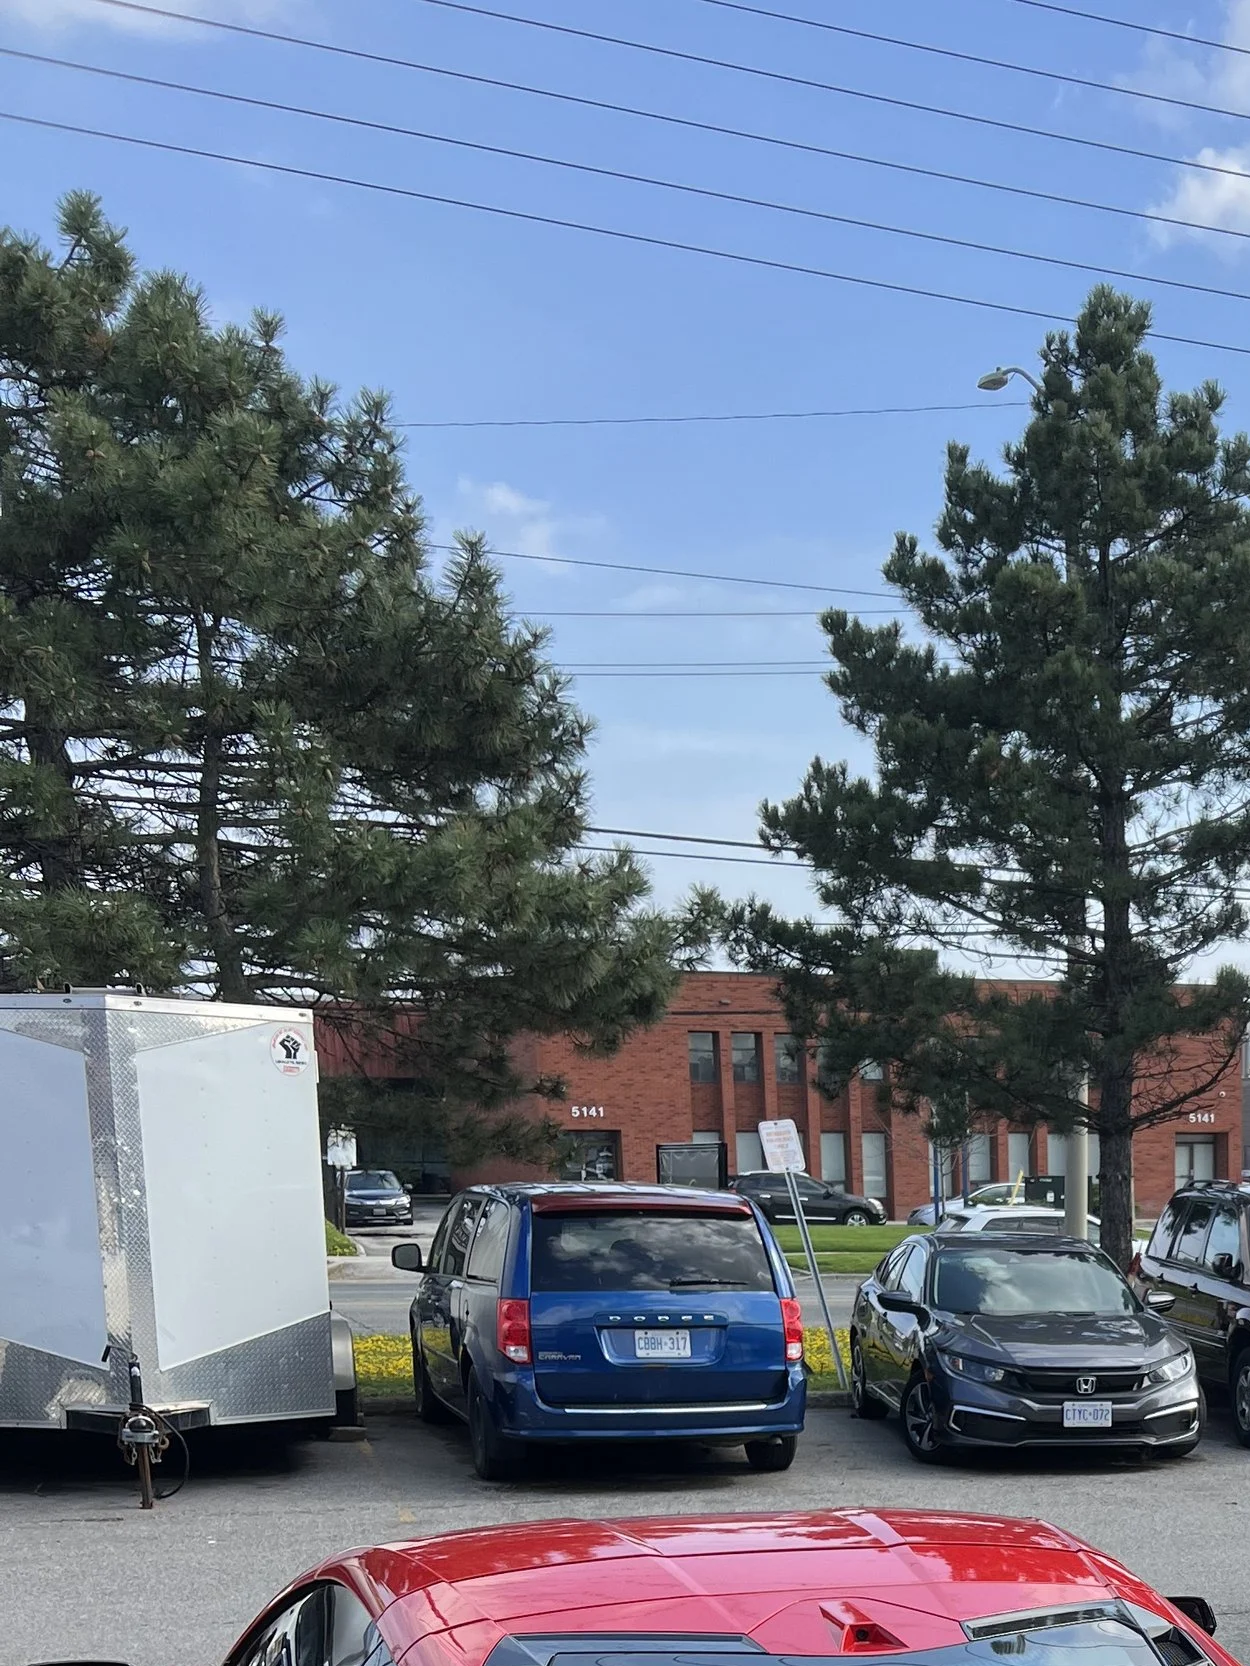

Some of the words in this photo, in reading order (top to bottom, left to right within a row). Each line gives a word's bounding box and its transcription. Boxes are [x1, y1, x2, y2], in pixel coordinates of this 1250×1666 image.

[571, 1105, 604, 1118] 5141
[1189, 1112, 1215, 1123] 5141
[1066, 1408, 1089, 1421] CTYC
[1092, 1408, 1110, 1421] 072
